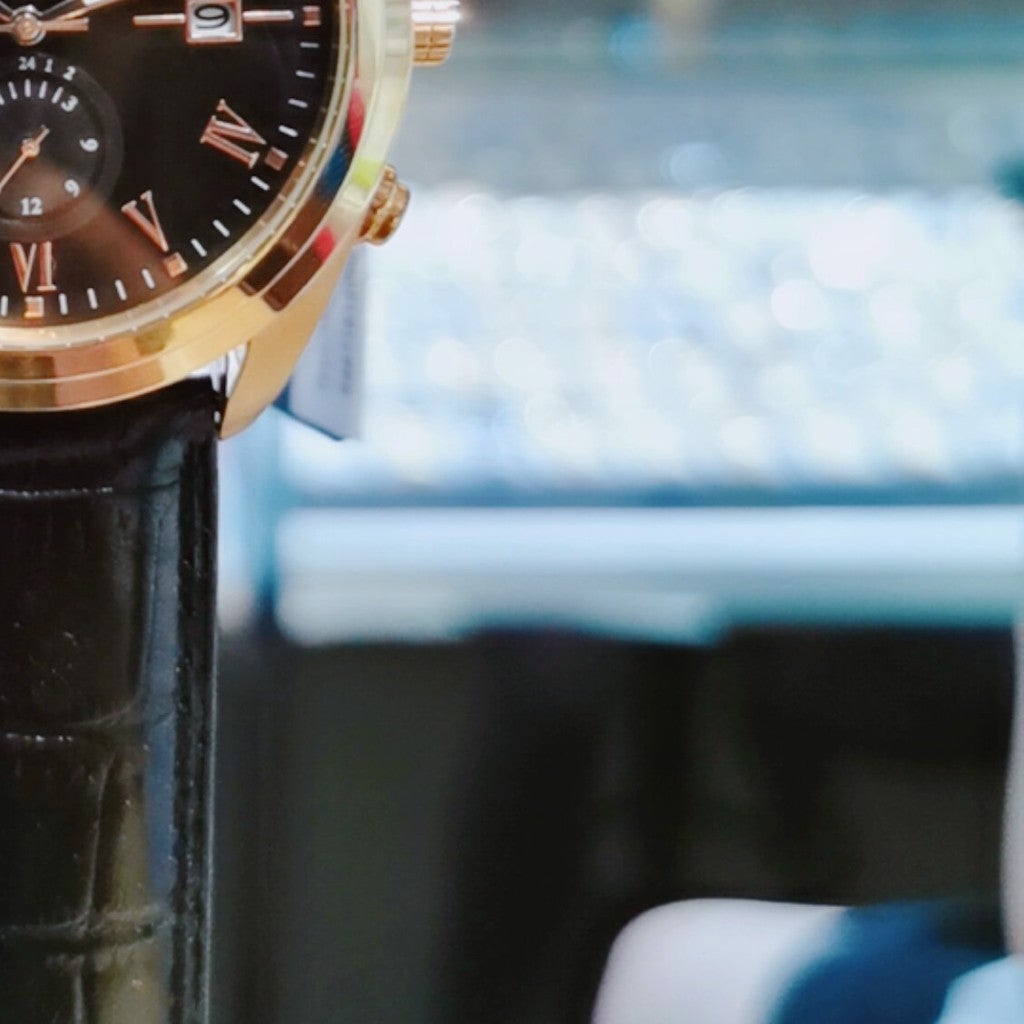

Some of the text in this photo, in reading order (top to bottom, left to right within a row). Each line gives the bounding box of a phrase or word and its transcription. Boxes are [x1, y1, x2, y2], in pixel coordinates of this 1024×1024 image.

[18, 56, 36, 71] 24
[44, 58, 53, 73] 1
[63, 66, 76, 81] 2
[61, 95, 79, 112] 3
[200, 98, 267, 170] IV
[64, 179, 80, 198] 9
[20, 196, 43, 216] 12
[121, 190, 169, 253] V
[9, 240, 56, 292] VI
